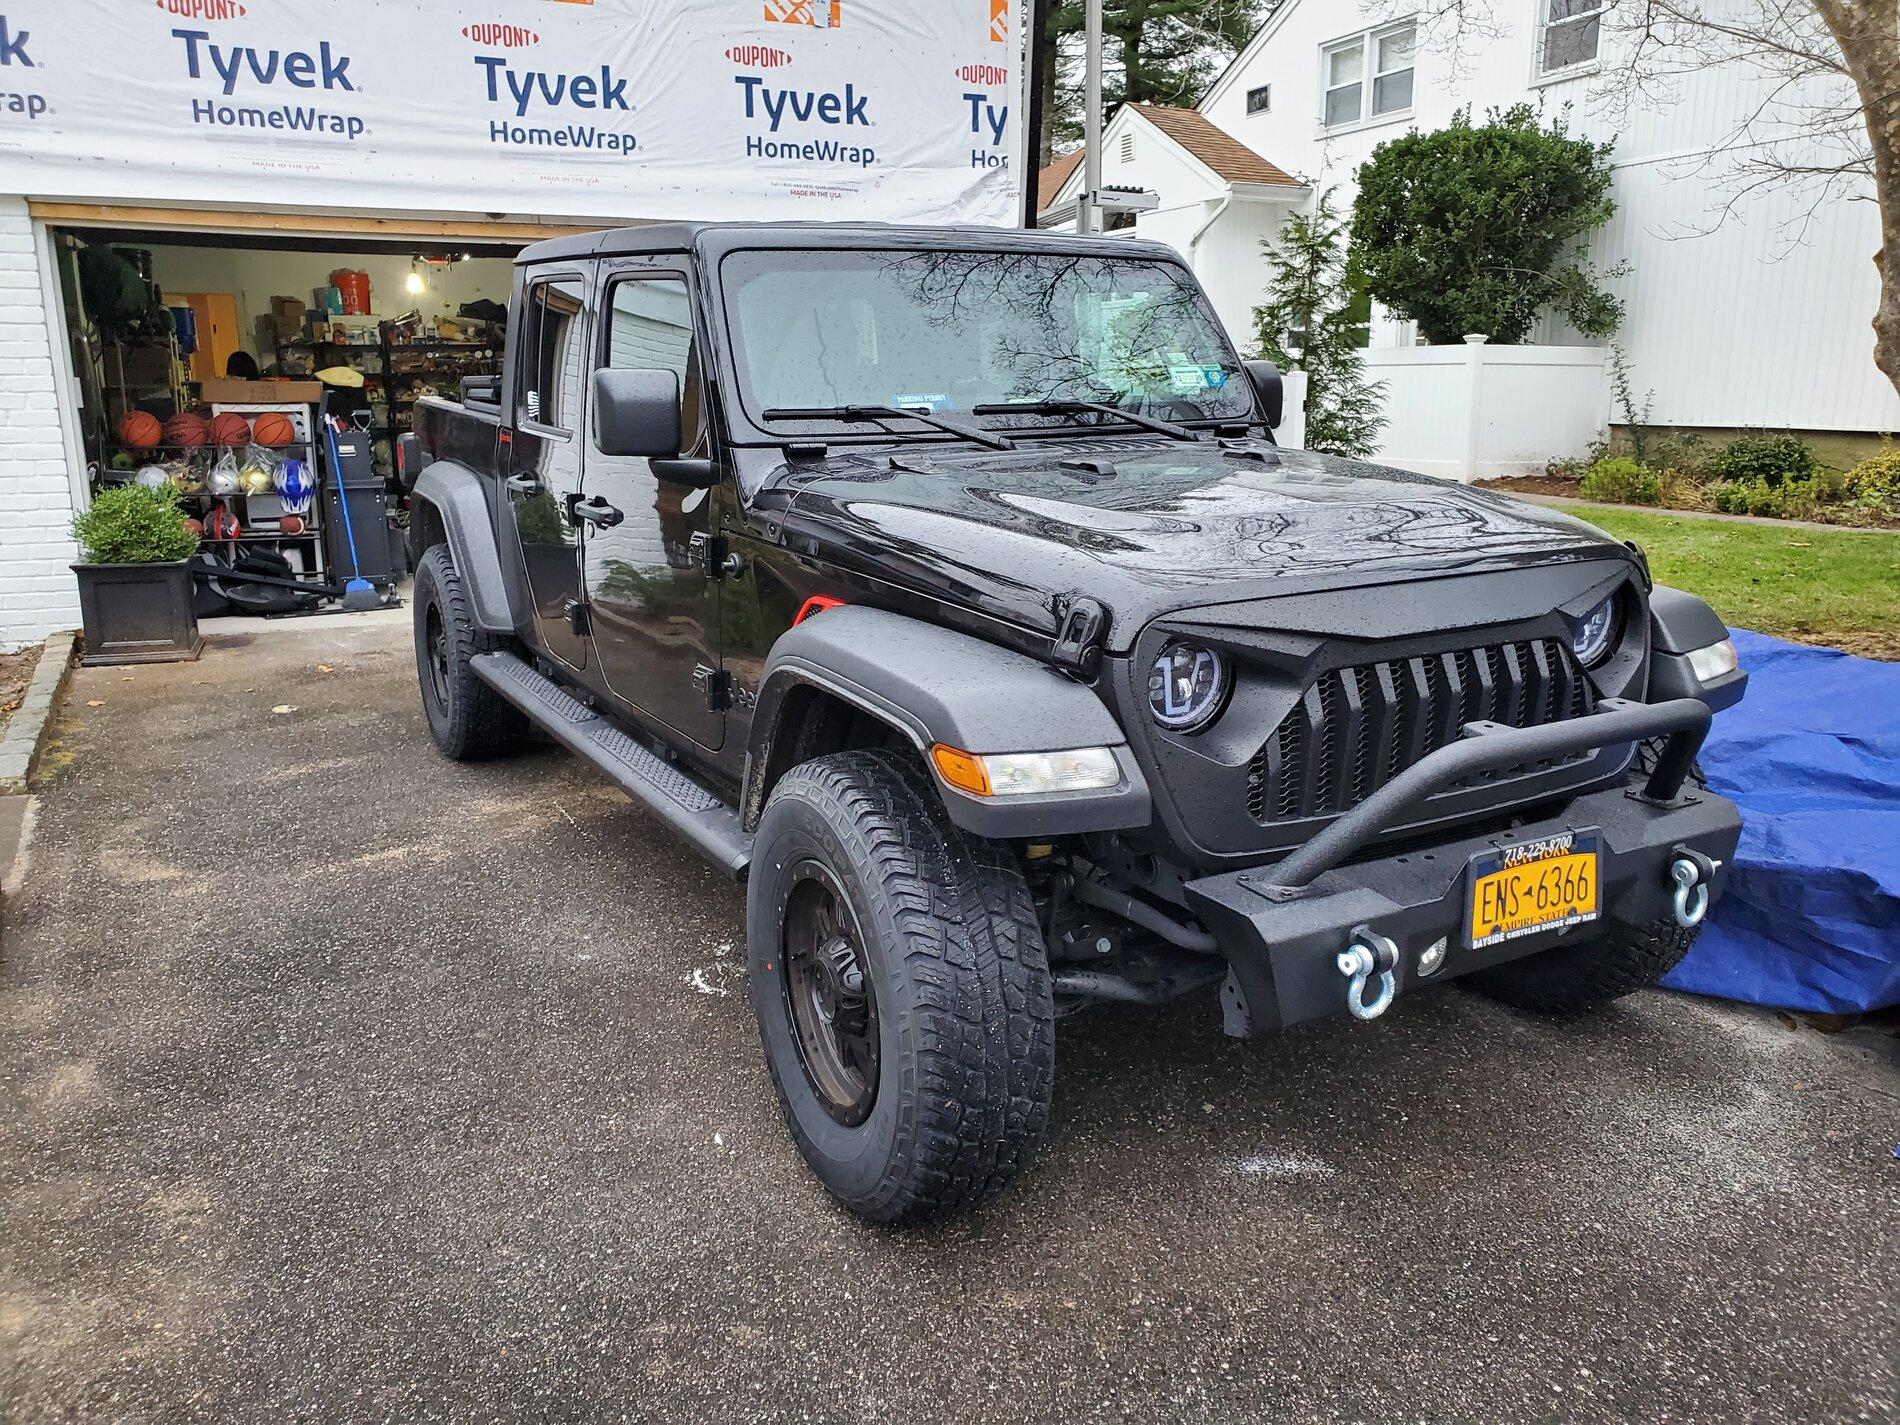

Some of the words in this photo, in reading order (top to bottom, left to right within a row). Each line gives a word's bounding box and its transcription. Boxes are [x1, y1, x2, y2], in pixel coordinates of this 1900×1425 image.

[471, 24, 530, 48] DUPONT
[172, 28, 354, 96] Tyvek
[733, 45, 785, 68] DUPONT
[474, 55, 630, 117] Tyvek
[962, 65, 1008, 85] DUPONT
[192, 99, 365, 140] HomeWrap
[734, 75, 870, 132] Tyvek
[490, 120, 637, 156] HomeWrap
[746, 136, 876, 168] HomeWrap
[790, 189, 809, 197] MADE
[817, 190, 829, 198] THE
[829, 191, 842, 199] USA
[896, 395, 924, 403] PARKING
[924, 393, 946, 402] PERMIT
[1505, 835, 1573, 862] 718-229-8700
[1536, 861, 1588, 910] 6366
[1472, 932, 1505, 949] BAYSIDE
[1507, 924, 1540, 939] CHRYSLER
[1541, 918, 1564, 931] DODGE
[1564, 915, 1581, 926] JEEP
[1582, 912, 1597, 922] RAM
[1540, 908, 1569, 922] STATE
